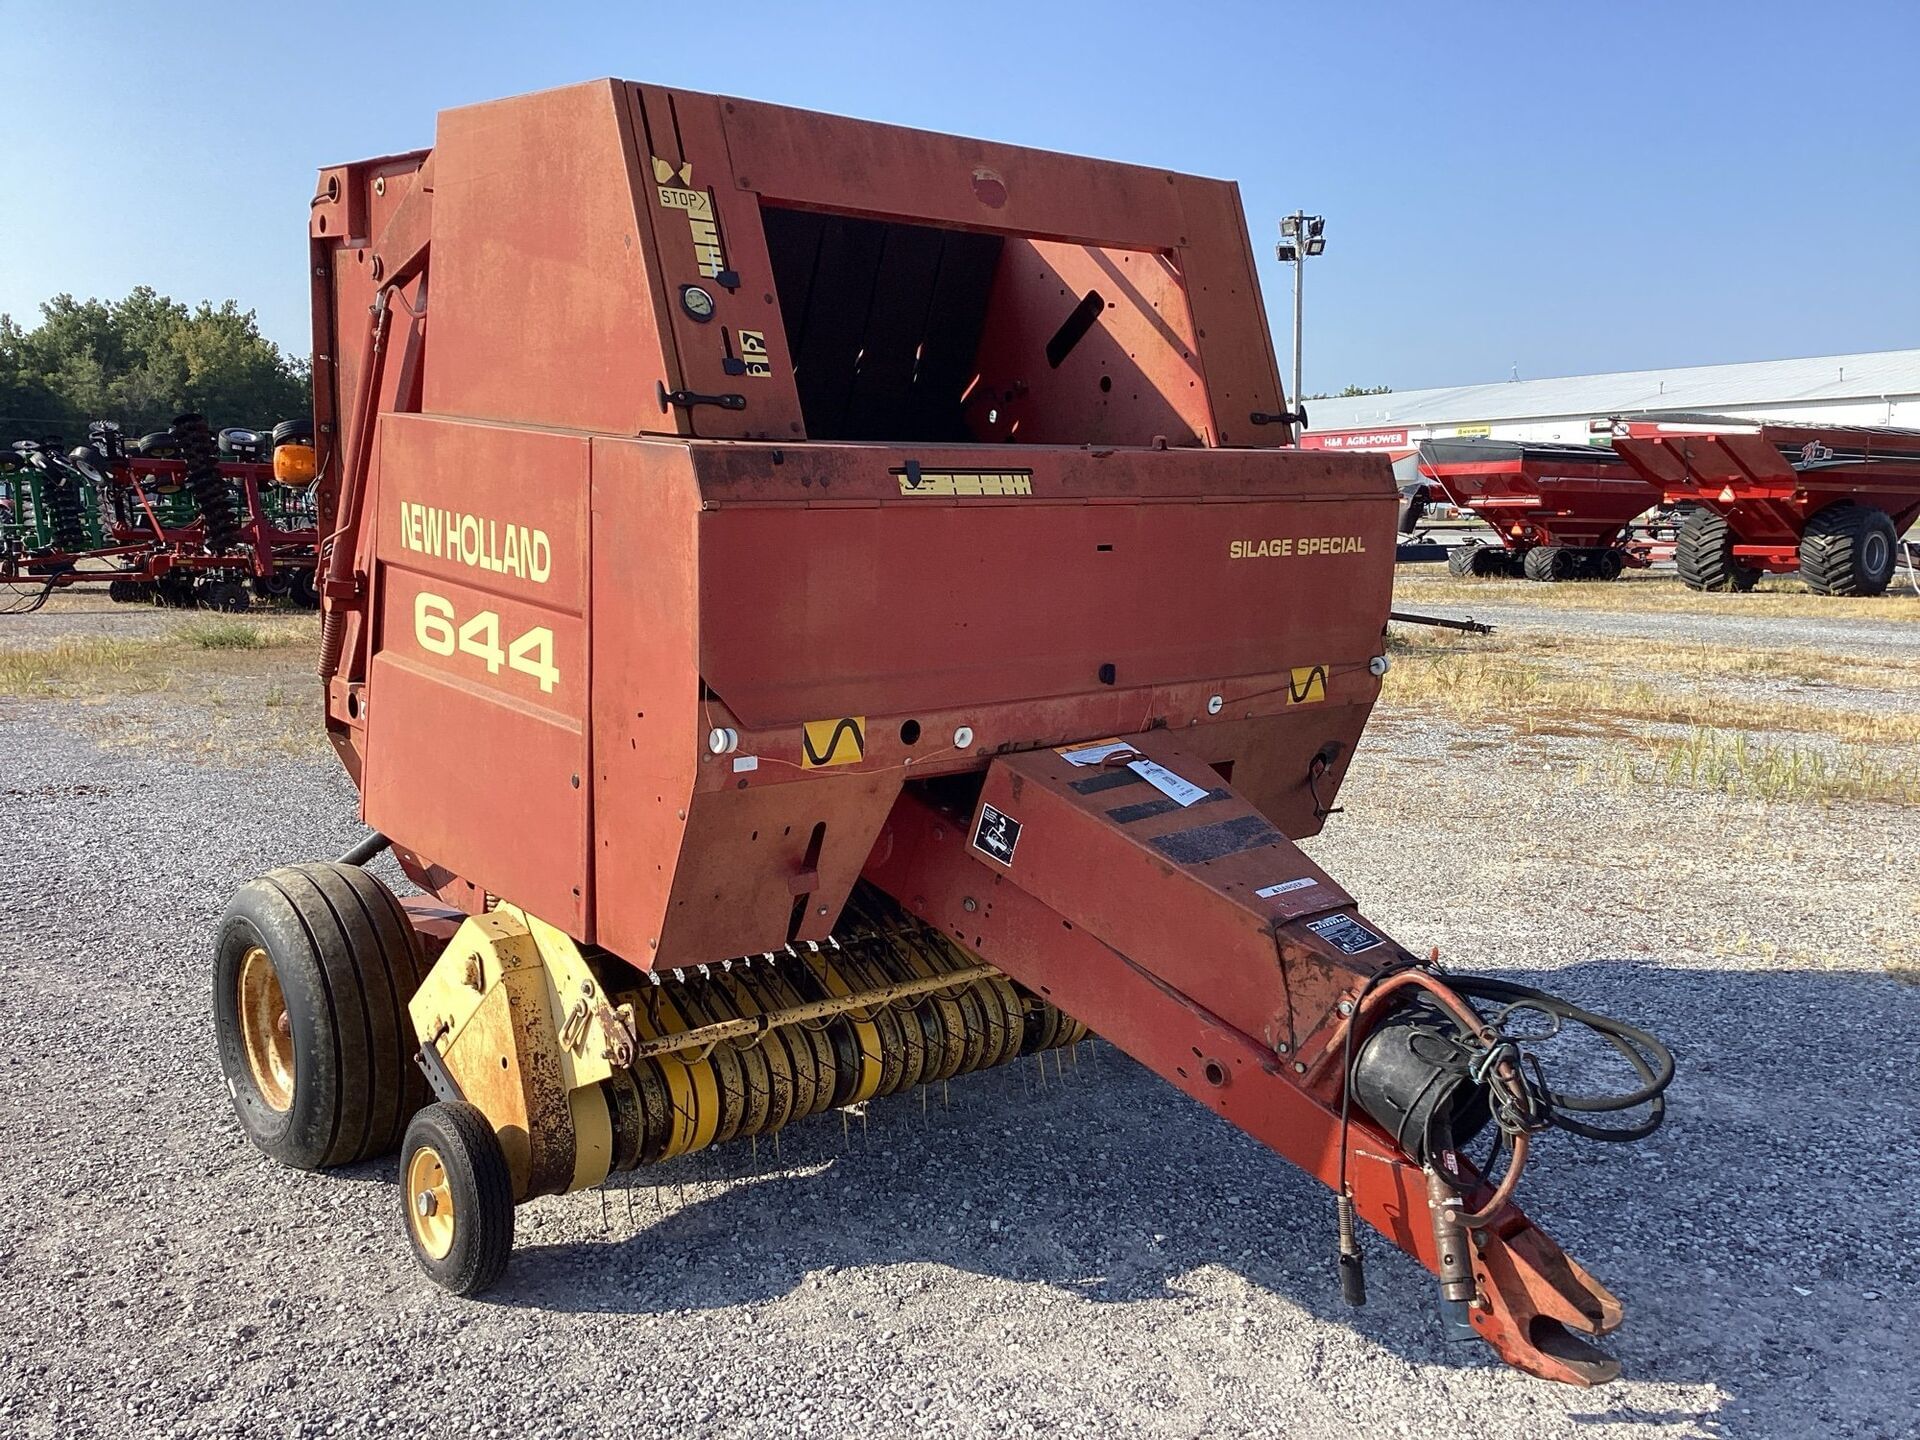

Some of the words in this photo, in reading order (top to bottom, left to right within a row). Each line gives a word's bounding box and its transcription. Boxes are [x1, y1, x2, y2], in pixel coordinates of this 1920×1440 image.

[661, 190, 697, 207] STOP
[1324, 437, 1343, 447] H&R
[1346, 433, 1402, 446] AGRI-POWER
[401, 501, 443, 558] NEW
[445, 512, 551, 584] HOLLAND
[1229, 539, 1293, 559] SILAGE
[1297, 536, 1366, 556] SPECIAL
[414, 591, 560, 694] 644
